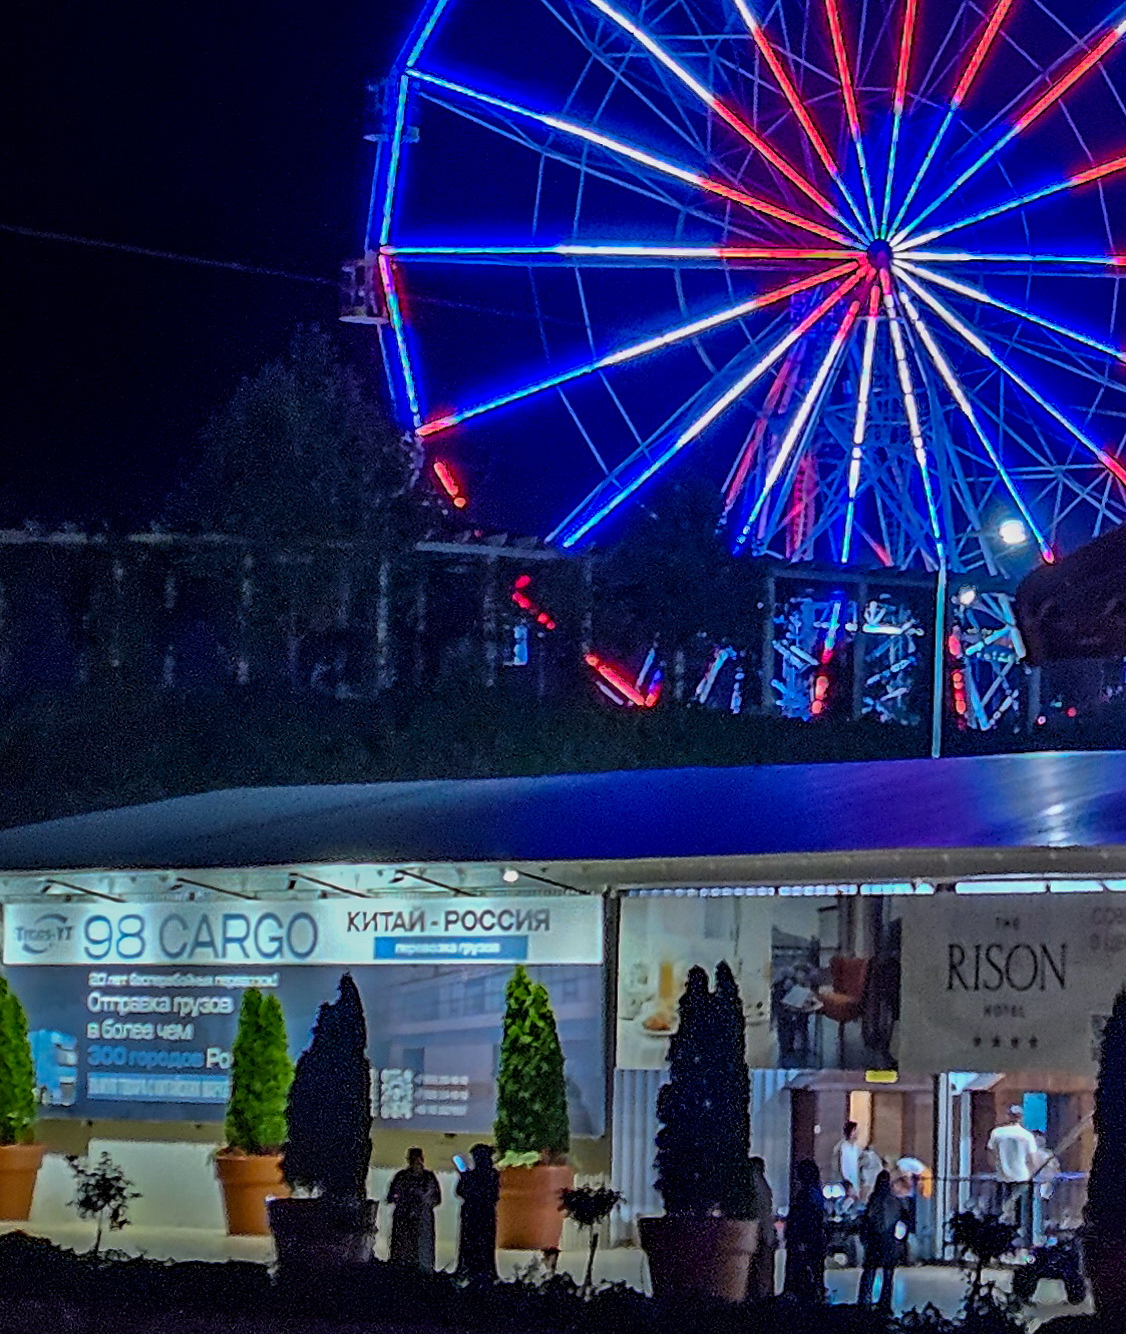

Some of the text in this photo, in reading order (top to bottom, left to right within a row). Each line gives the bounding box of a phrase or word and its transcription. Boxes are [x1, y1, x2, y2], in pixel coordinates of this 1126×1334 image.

[347, 907, 425, 932] КИТАЙ
[444, 909, 550, 932] РОССИЯ
[84, 912, 319, 960] 98 CARGO
[947, 942, 1067, 991] RISON
[87, 992, 234, 1017] Отправка грузов
[102, 1019, 155, 1040] более
[157, 1023, 195, 1040] чем
